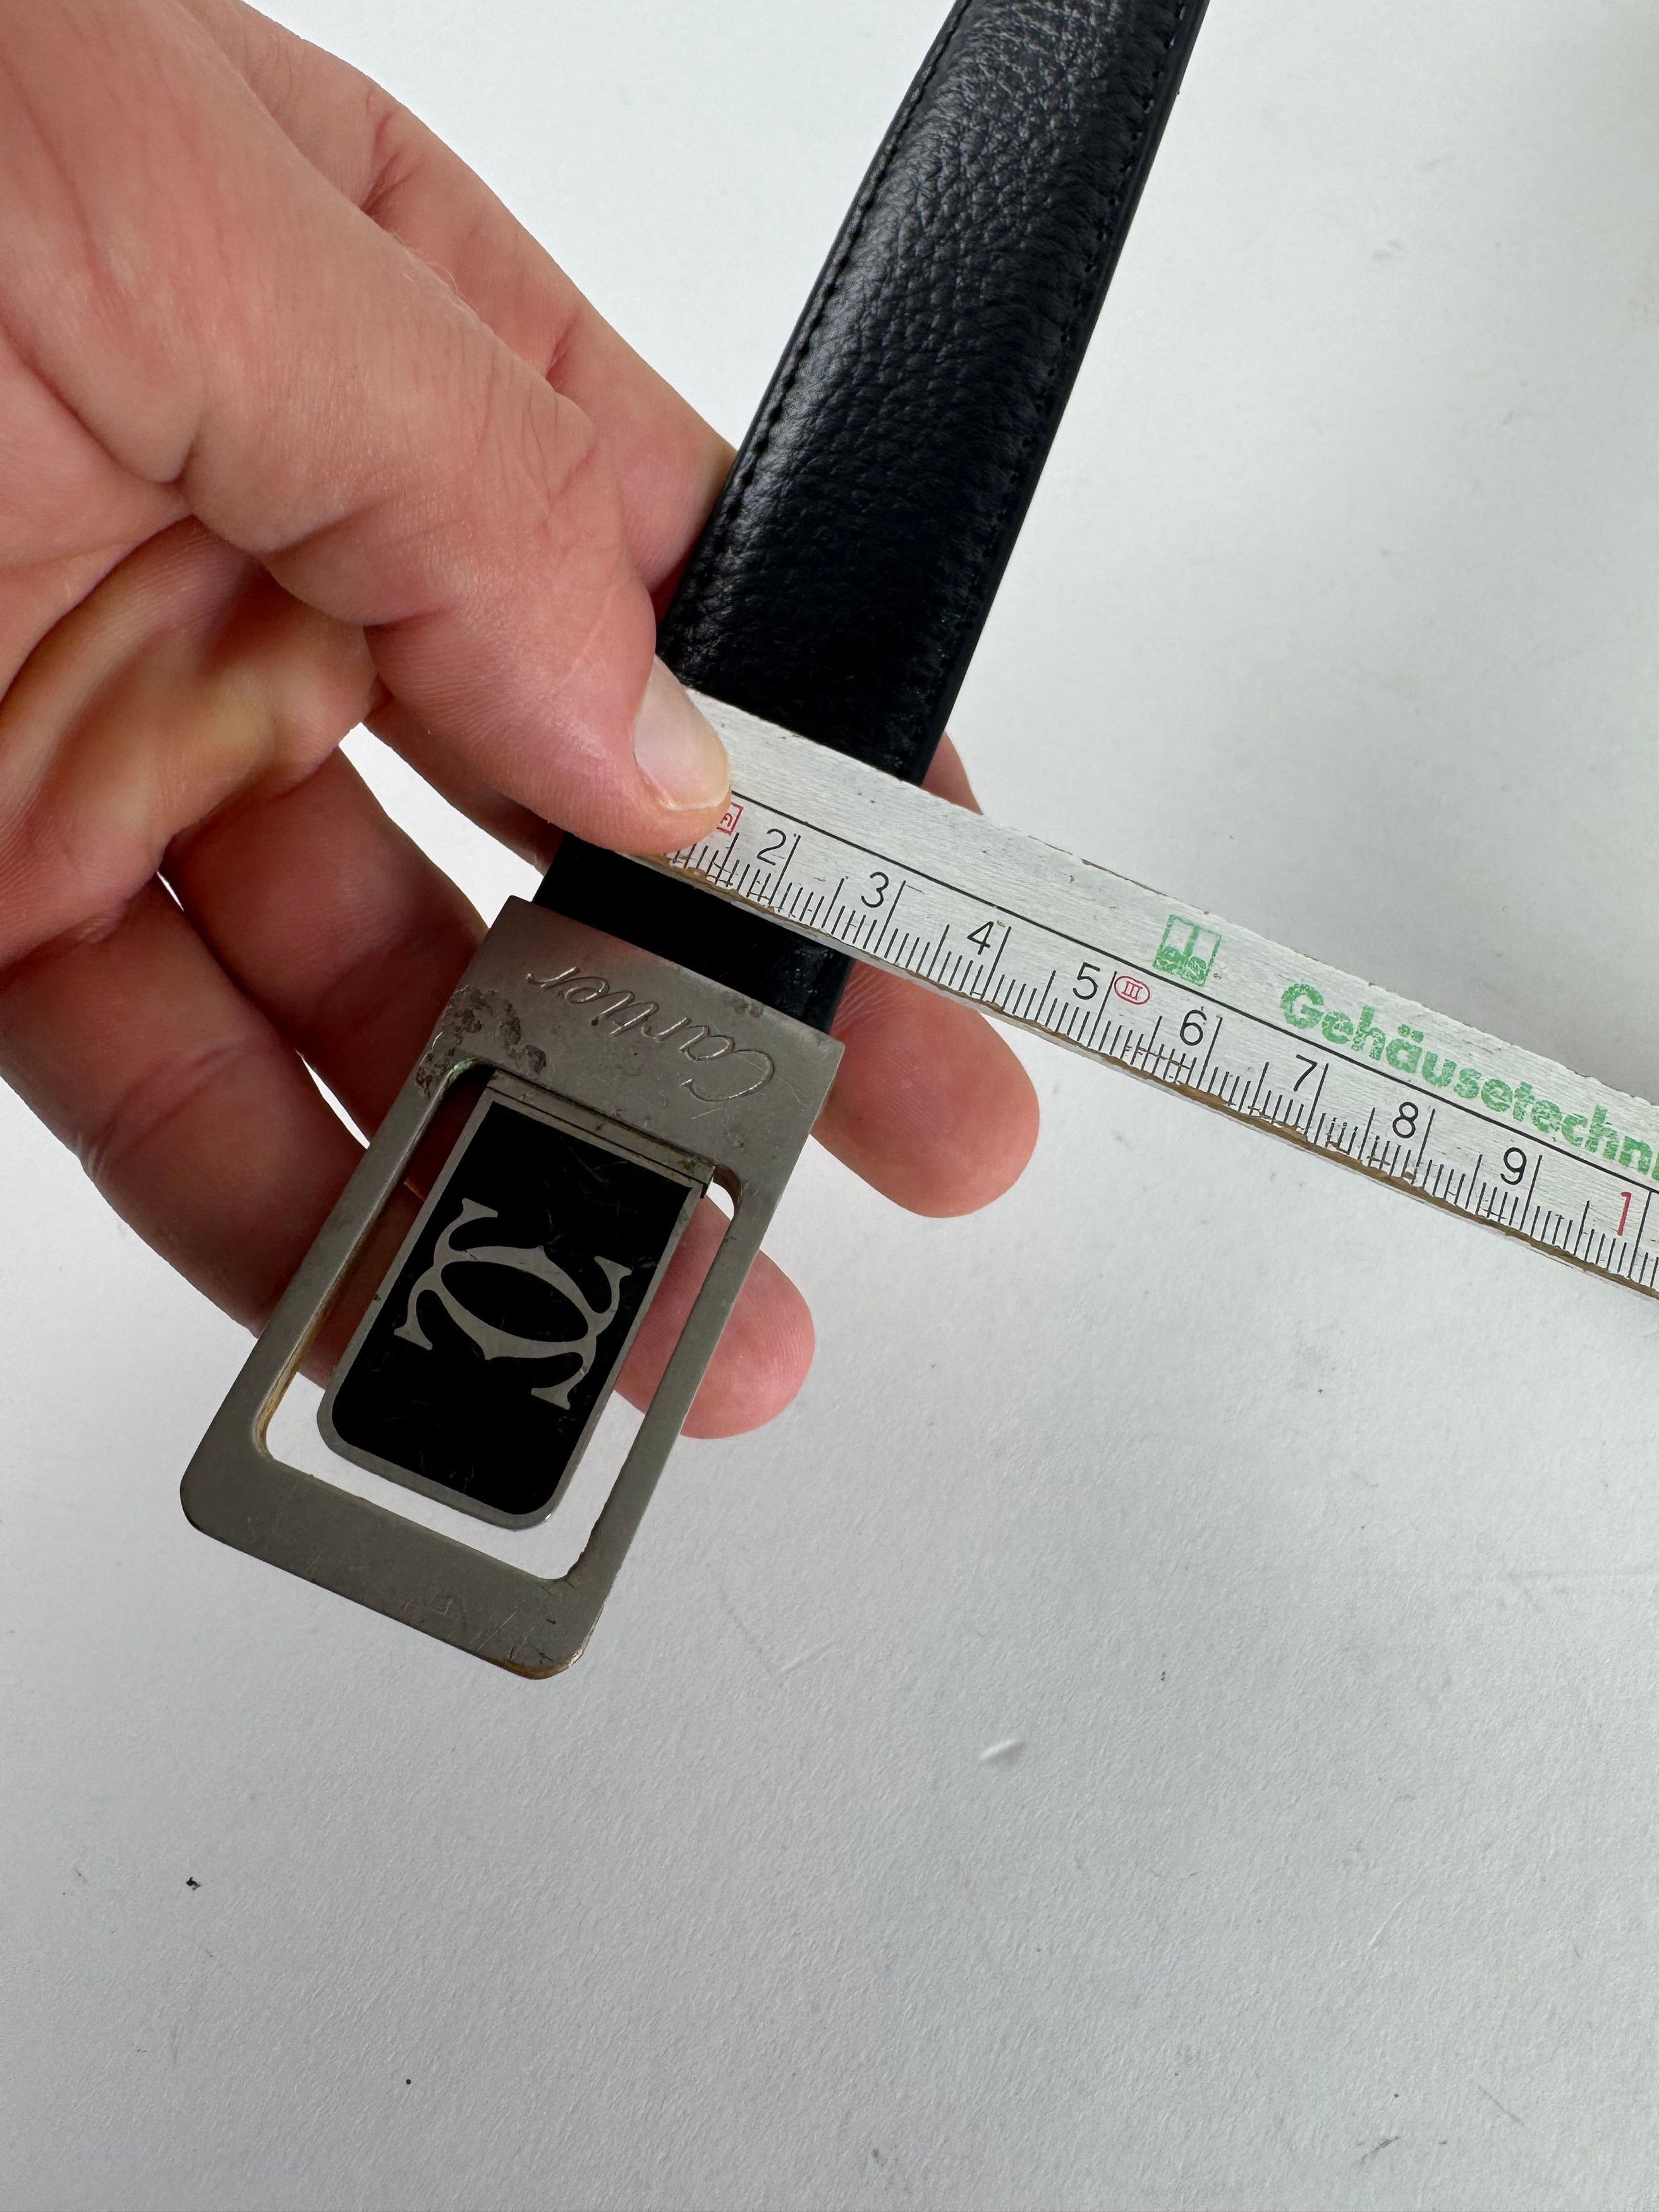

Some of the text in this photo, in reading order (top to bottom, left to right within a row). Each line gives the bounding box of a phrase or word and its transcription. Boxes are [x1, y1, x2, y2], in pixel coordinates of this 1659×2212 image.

[525, 966, 776, 1103] Cartier
[756, 828, 787, 866] 2
[860, 872, 890, 908] 3
[966, 921, 995, 956] 4
[1073, 962, 1101, 1000] 5
[1179, 1009, 1207, 1046] 6
[1293, 1054, 1318, 1092] 7
[1392, 1101, 1419, 1139] 8
[1500, 1146, 1528, 1186] 9
